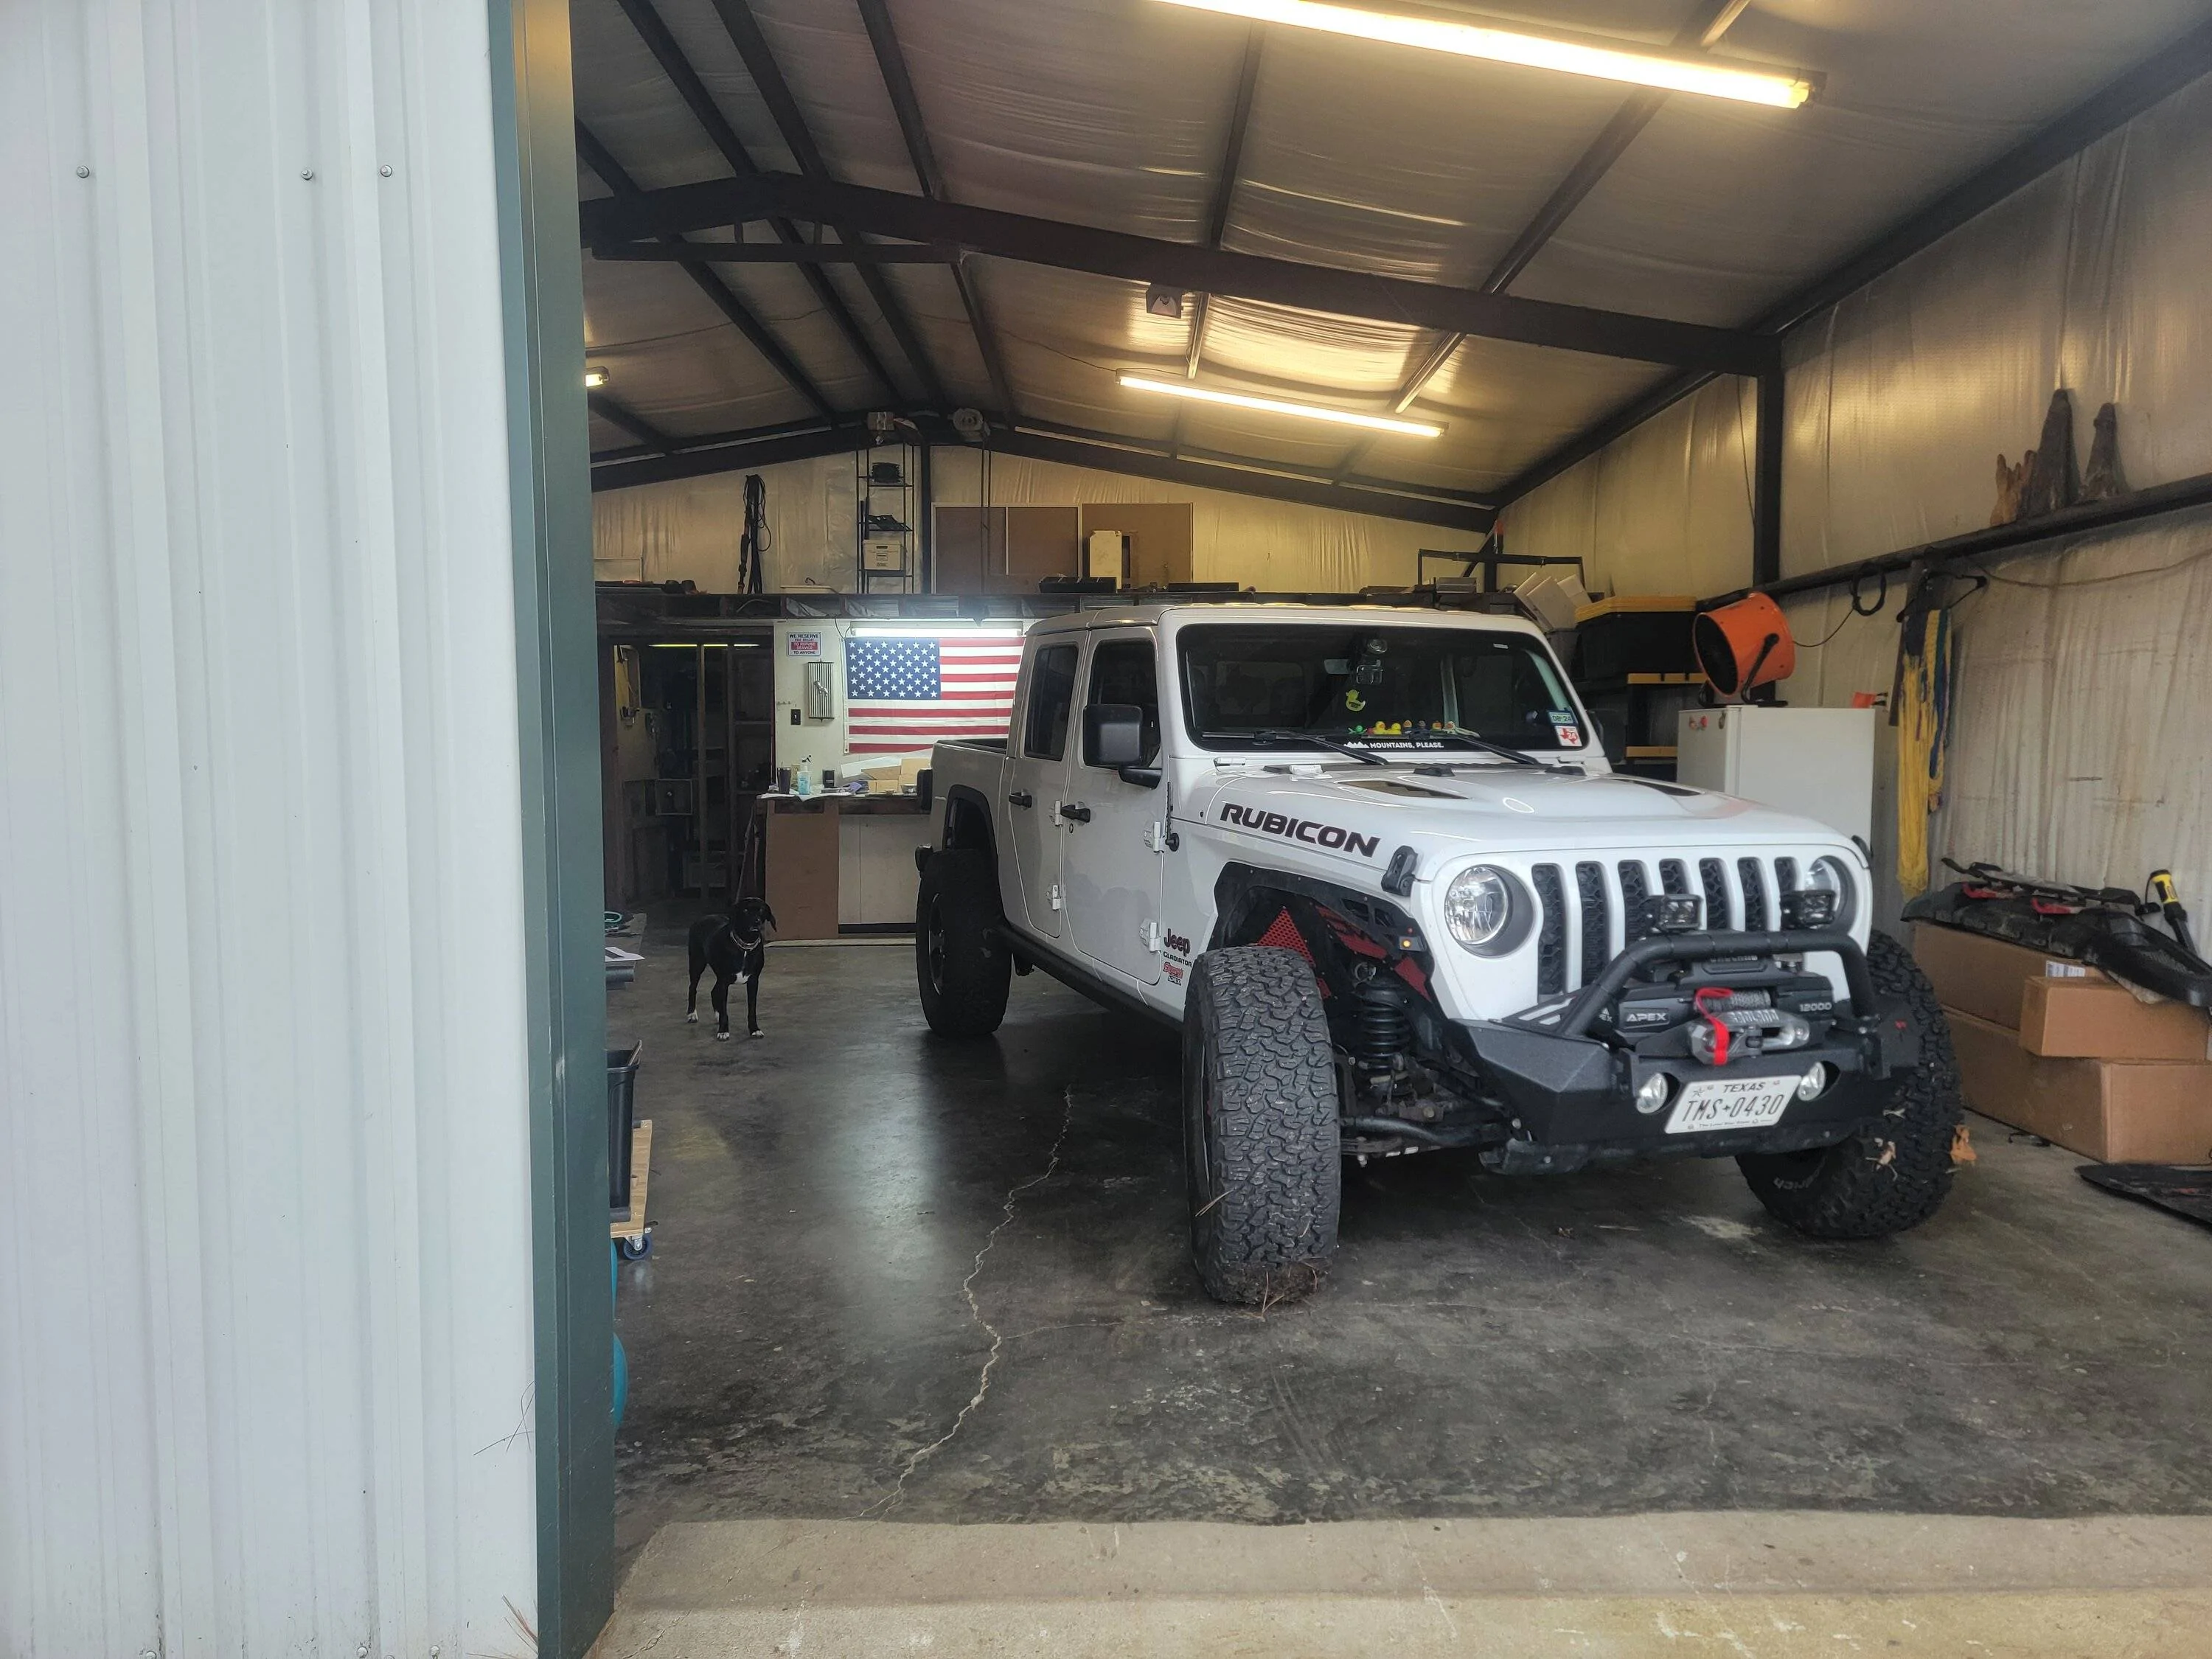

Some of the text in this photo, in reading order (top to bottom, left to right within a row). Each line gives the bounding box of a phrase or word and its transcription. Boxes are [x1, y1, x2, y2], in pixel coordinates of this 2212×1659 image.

[1220, 802, 1381, 858] RUBICON
[1164, 928, 1191, 957] Jeep
[1163, 951, 1192, 968] GLADIATOR
[1799, 1002, 1832, 1012] 12000
[1626, 1012, 1666, 1023] APEX
[1723, 1082, 1766, 1093] TEXAS
